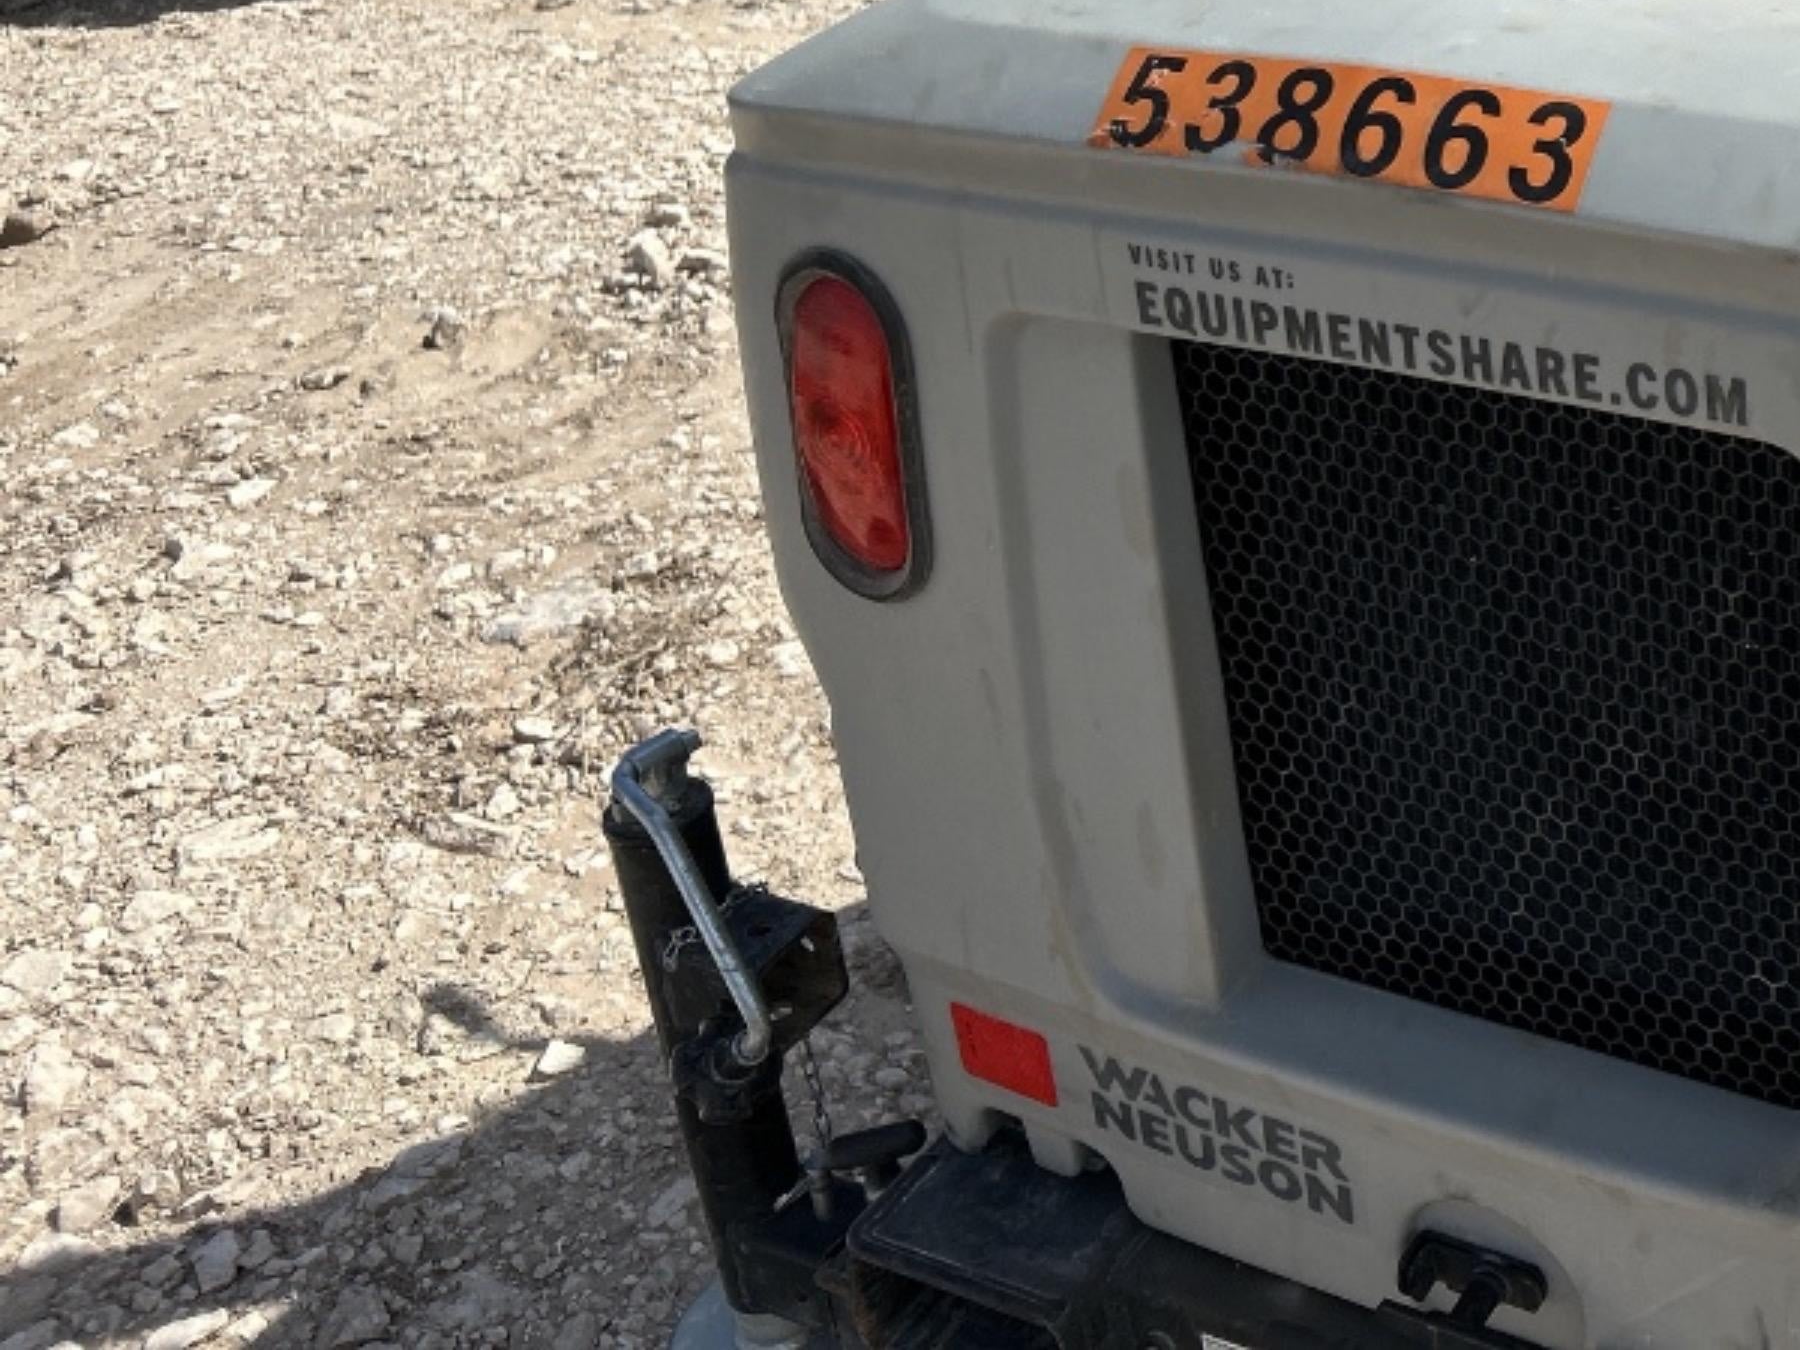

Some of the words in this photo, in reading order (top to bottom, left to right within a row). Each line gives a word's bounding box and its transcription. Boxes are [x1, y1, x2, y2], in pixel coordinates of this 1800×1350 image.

[1109, 53, 1588, 203] 538663
[1127, 242, 1195, 275] VISIT
[1208, 257, 1241, 283] US
[1255, 266, 1295, 290] AT:
[1133, 279, 1750, 428] EQUIPMENTSHARE.COM
[1078, 1043, 1351, 1182] WACKER
[1090, 1091, 1355, 1225] NEUSON
